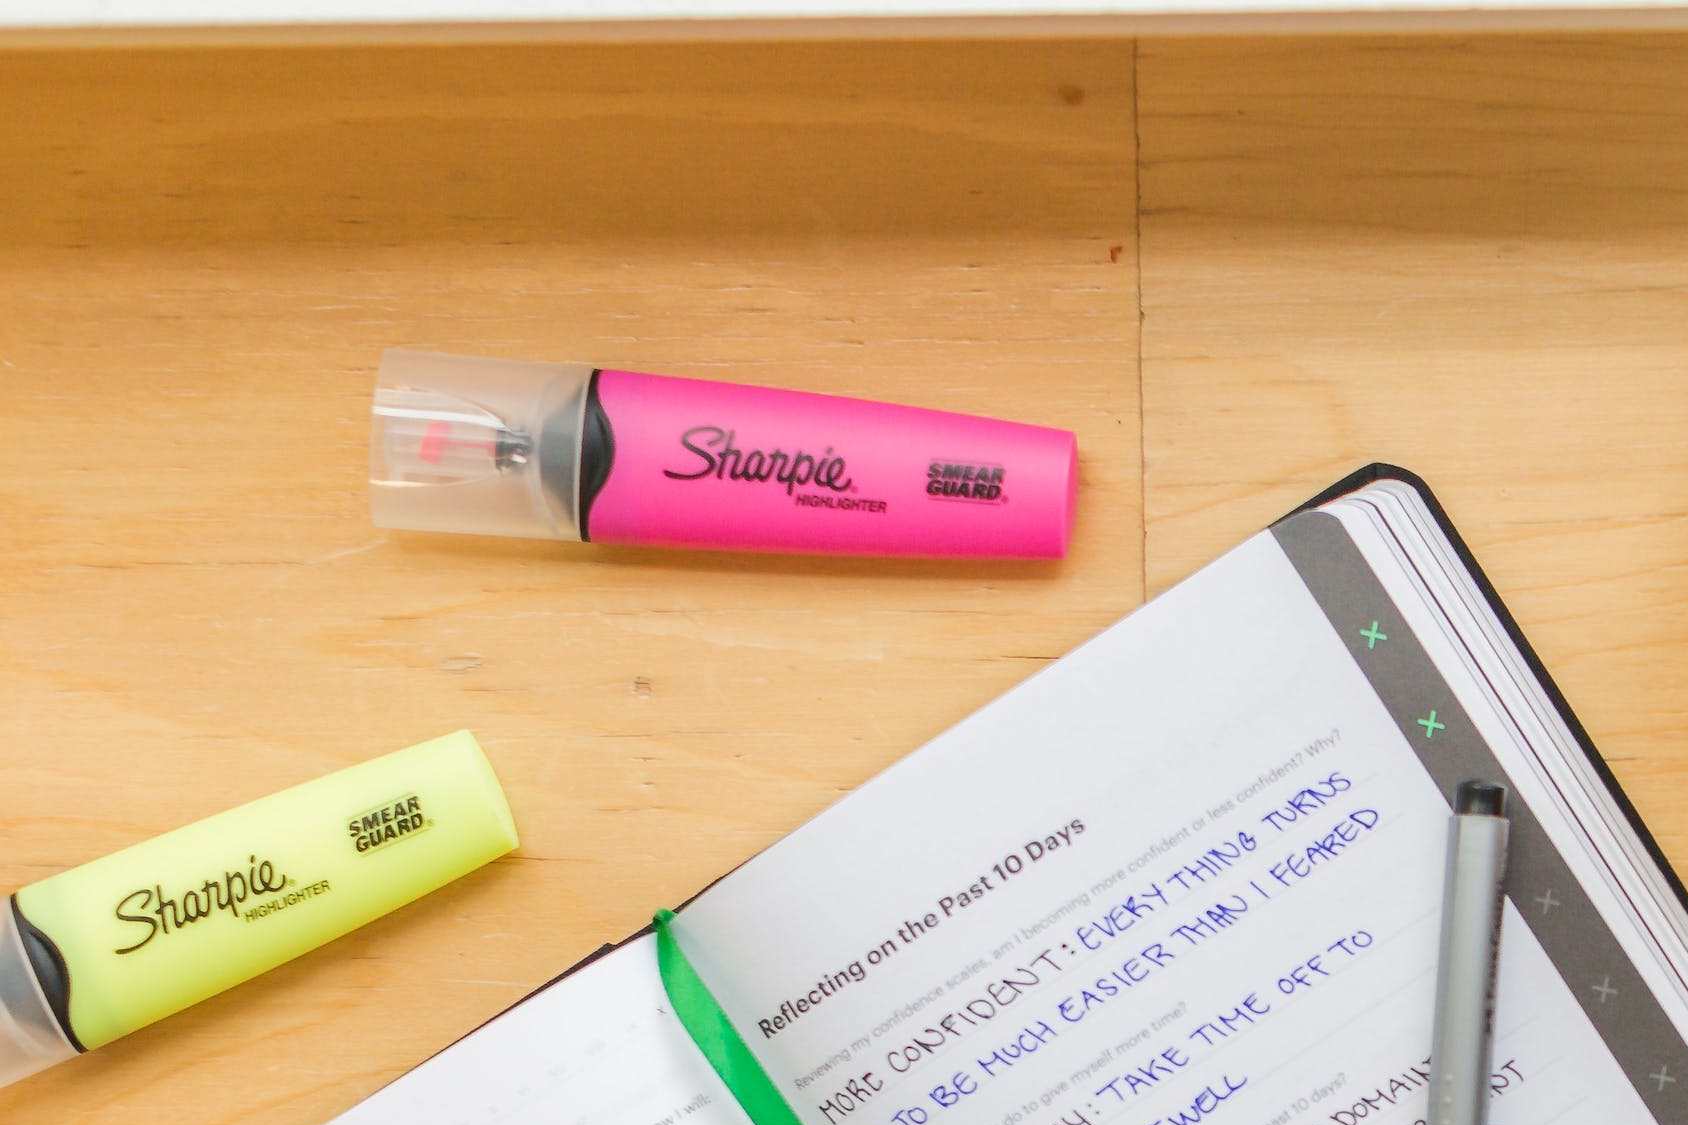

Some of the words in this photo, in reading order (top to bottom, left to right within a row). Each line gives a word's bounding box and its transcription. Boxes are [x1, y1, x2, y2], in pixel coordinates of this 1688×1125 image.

[664, 426, 852, 496] Sharpie
[795, 494, 888, 513] HIGHLIGHTER
[926, 461, 1005, 484] SMEAR
[349, 796, 422, 837] SMEAR
[115, 854, 286, 955] Sharpie
[244, 879, 332, 923] HIGHLIGHTER
[756, 960, 866, 1040] Reflecting
[866, 938, 898, 965] on
[896, 912, 939, 944] the
[937, 875, 995, 918] Past
[991, 853, 1024, 881] 10
[1023, 818, 1086, 863] Days
[792, 1048, 851, 1092] Reviewing
[849, 1034, 871, 1053] my
[870, 985, 944, 1038] confidence
[991, 940, 1015, 961] am
[1019, 891, 1092, 940] becoming
[1089, 868, 1127, 897] more
[1126, 826, 1192, 873] confident
[1190, 816, 1207, 832] or
[1205, 799, 1236, 821] less
[1235, 751, 1304, 804] confident?
[1303, 727, 1341, 758] Why?
[817, 1071, 884, 1125] MORE
[1260, 771, 1352, 831] TURNS
[927, 1071, 978, 1108] BE
[976, 1019, 1057, 1077] MUCH
[1057, 942, 1176, 1023] EASIER
[1169, 894, 1249, 945] THAN
[1248, 879, 1271, 900] I
[1268, 808, 1379, 887] FEARED
[1094, 1046, 1190, 1101] TAKE
[1188, 992, 1271, 1046] TIME
[1277, 953, 1330, 995] OFF
[1326, 929, 1374, 956] TO
[683, 1092, 713, 1115] will:
